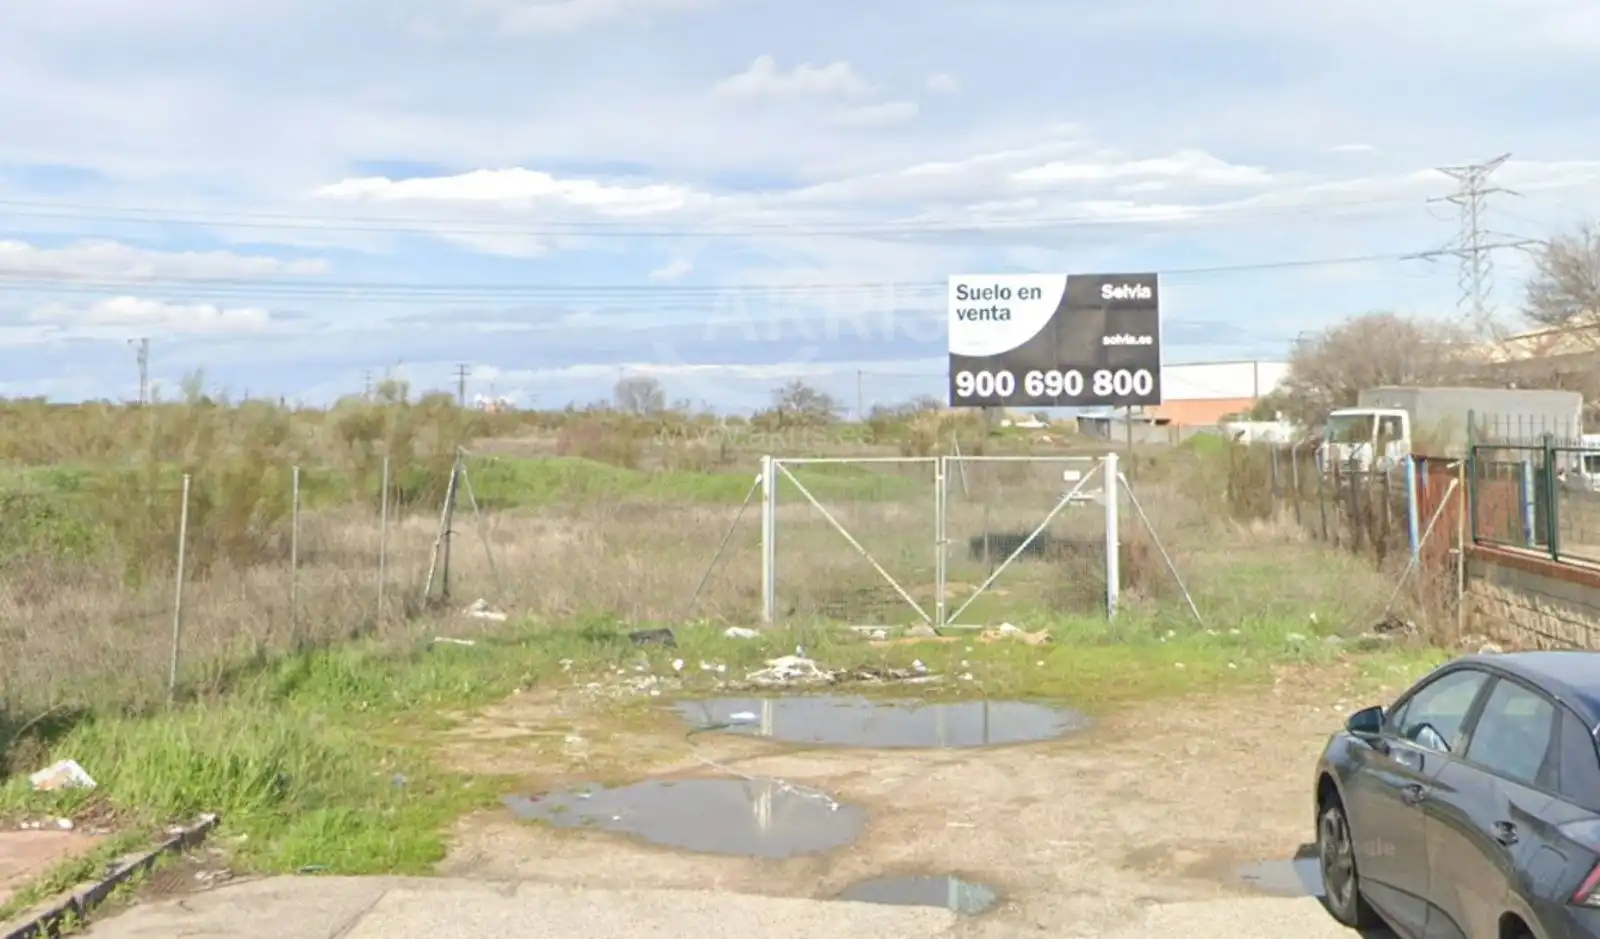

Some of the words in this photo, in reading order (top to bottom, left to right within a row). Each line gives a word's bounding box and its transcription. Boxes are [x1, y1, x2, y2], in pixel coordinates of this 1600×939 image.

[956, 284, 1012, 301] Suelo
[1017, 287, 1042, 300] en
[956, 306, 1011, 321] venta
[956, 370, 1015, 397] 900
[1024, 370, 1084, 396] 690
[1092, 369, 1153, 396] 800
